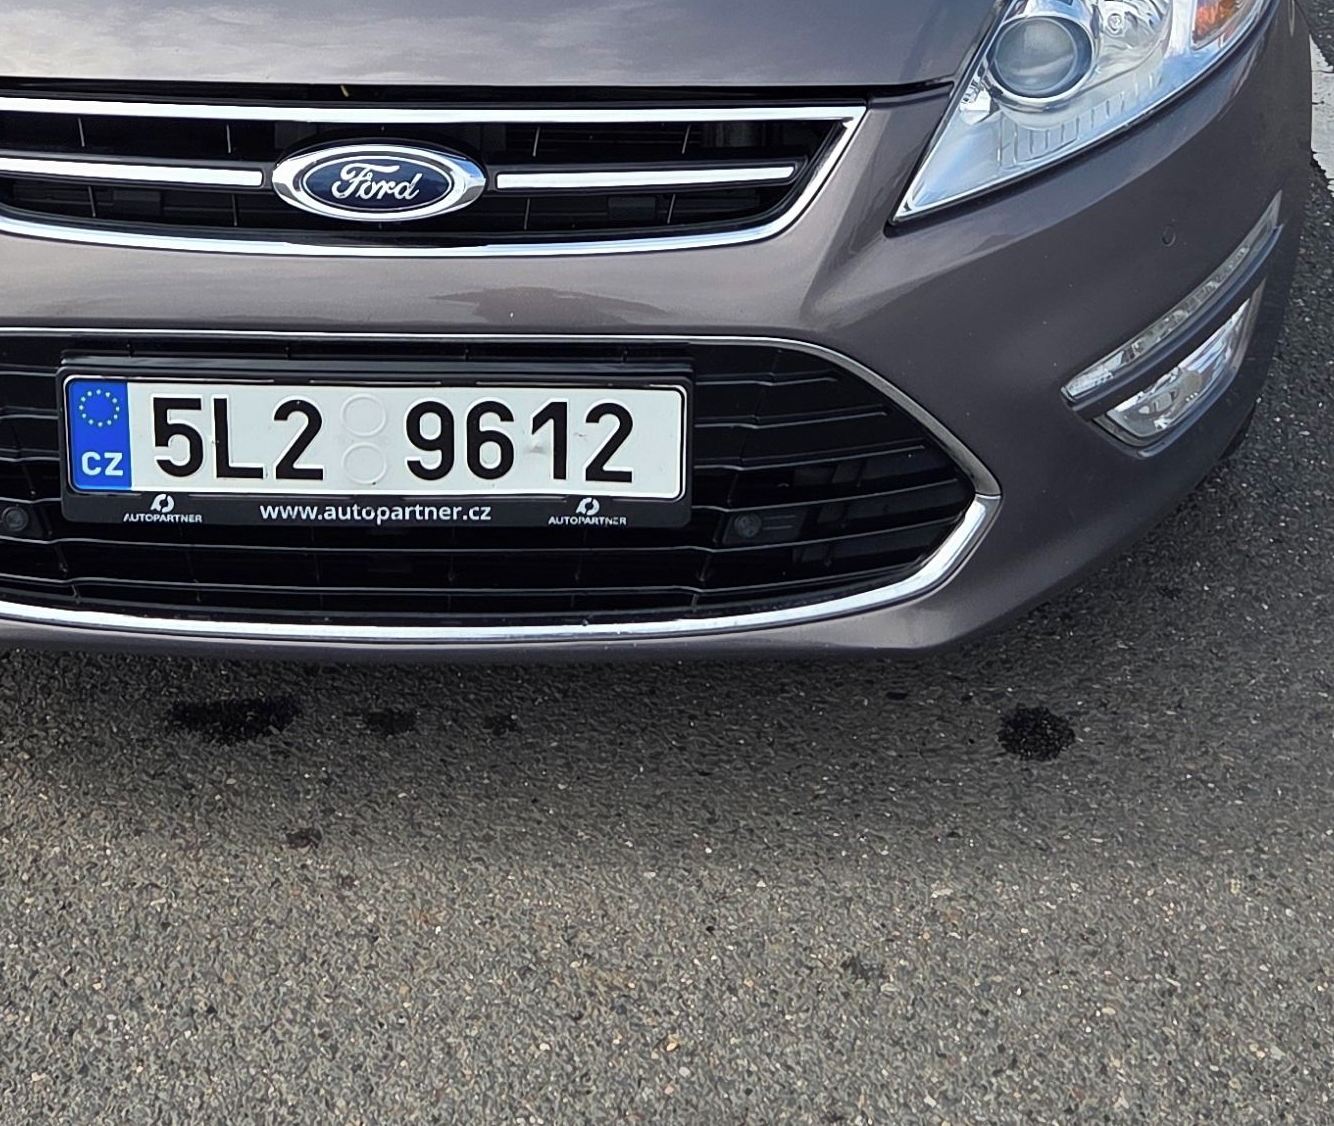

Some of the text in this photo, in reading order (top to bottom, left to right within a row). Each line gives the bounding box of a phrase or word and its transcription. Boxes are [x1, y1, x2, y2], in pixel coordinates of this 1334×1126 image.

[331, 163, 423, 200] Ford
[153, 396, 634, 483] 5L2 9612
[81, 451, 124, 477] CZ
[123, 513, 203, 523] AUTOPARTNER
[259, 503, 492, 525] www.autopartner.cz
[548, 515, 627, 525] AUTOPARTNER
